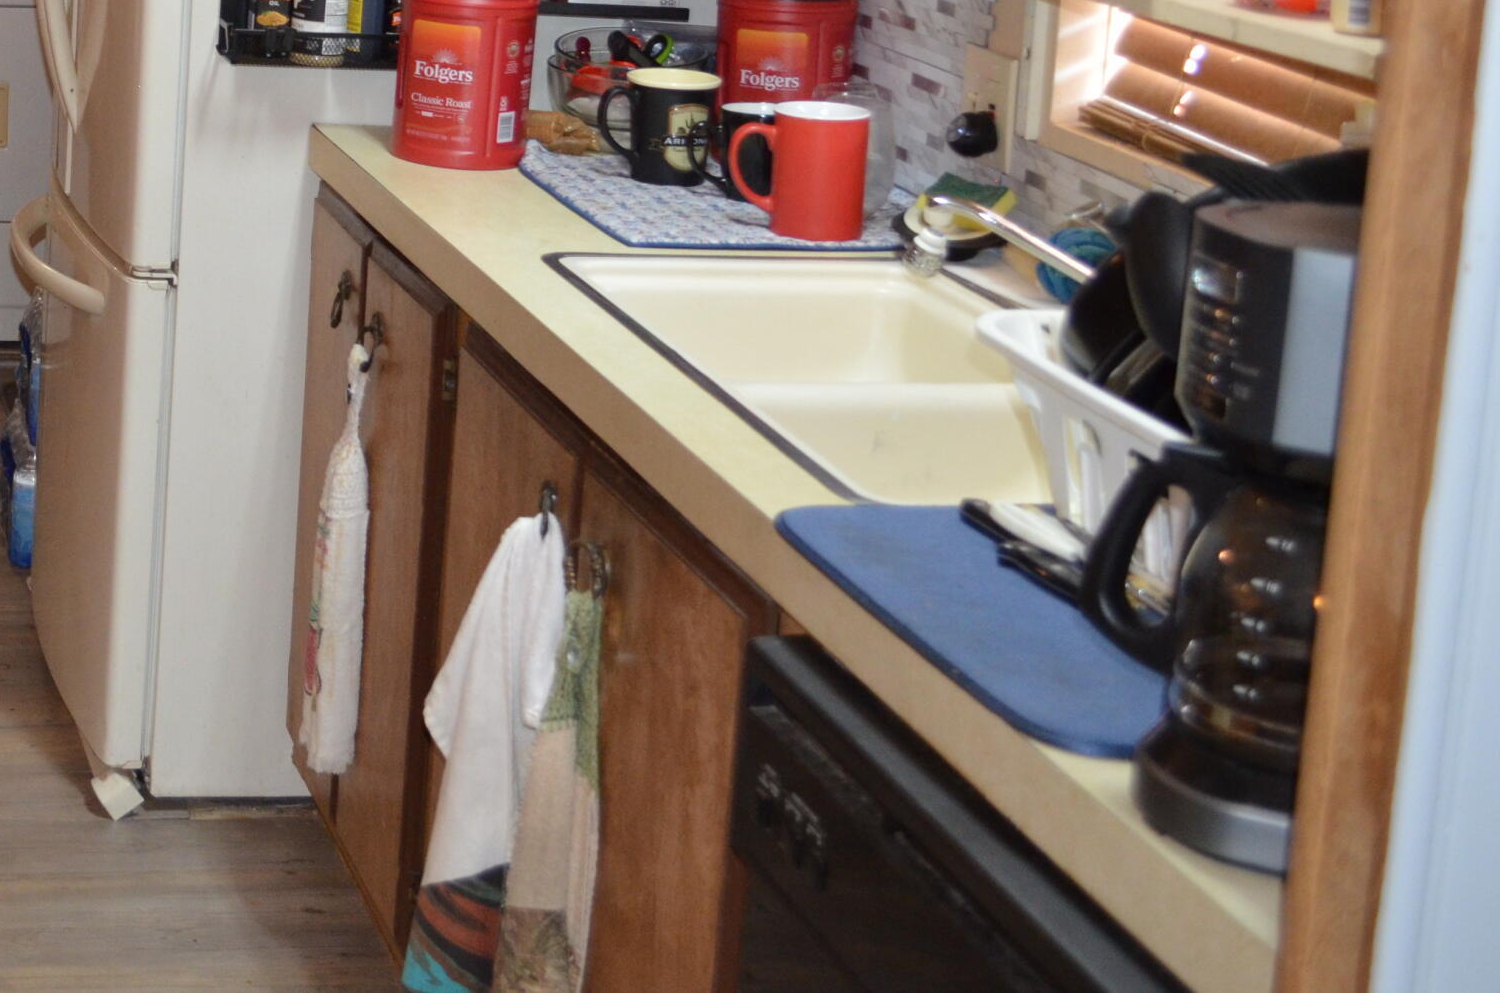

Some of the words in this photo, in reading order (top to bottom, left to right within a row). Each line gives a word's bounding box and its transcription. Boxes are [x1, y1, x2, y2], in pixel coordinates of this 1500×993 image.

[414, 59, 474, 84] Folgers
[739, 68, 800, 92] Folgers
[411, 92, 444, 105] Classic
[445, 97, 473, 110] Roast
